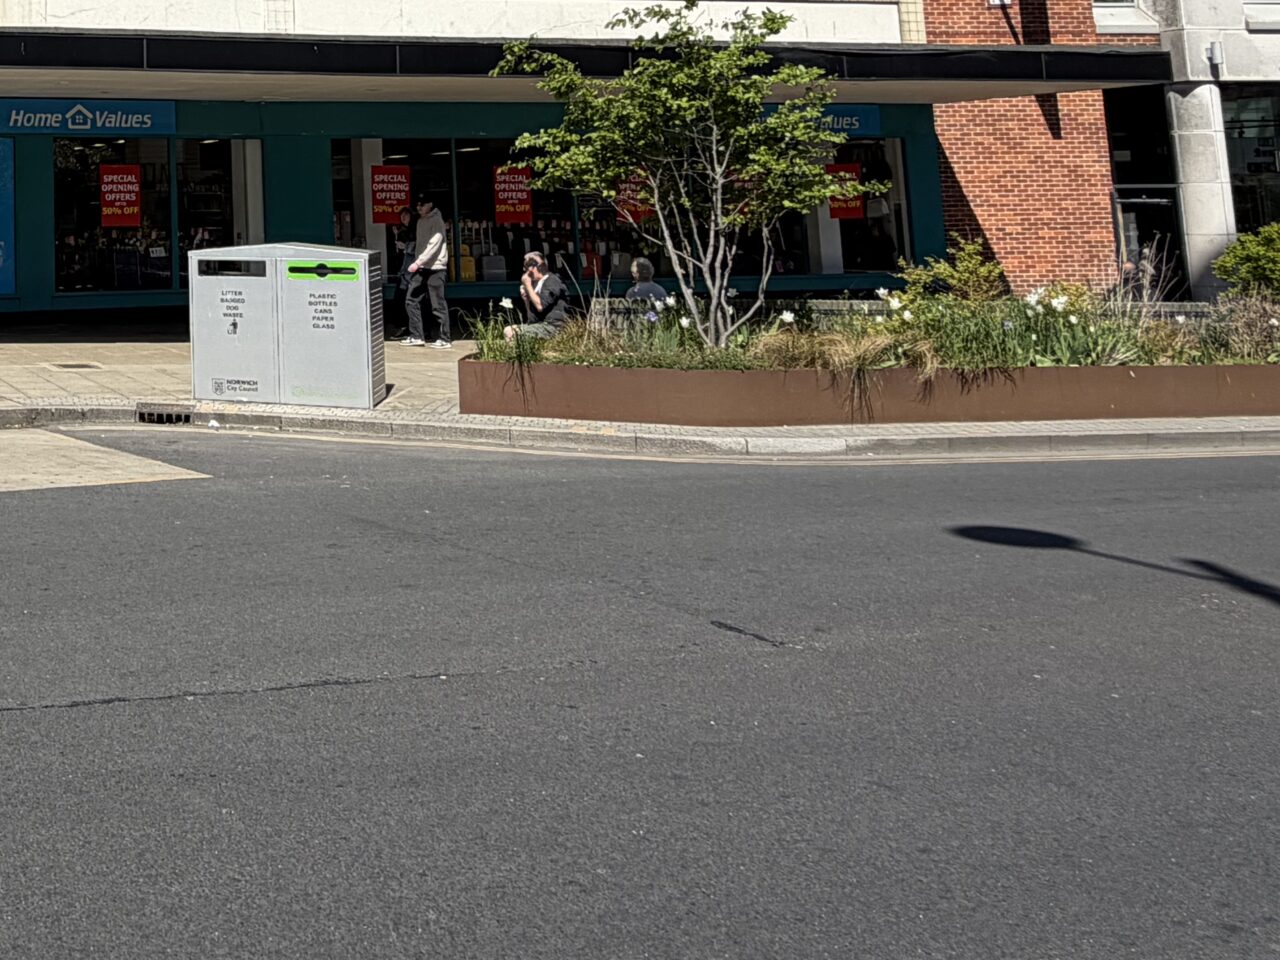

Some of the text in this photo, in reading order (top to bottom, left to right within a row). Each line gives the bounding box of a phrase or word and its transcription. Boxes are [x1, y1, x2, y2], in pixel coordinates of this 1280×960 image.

[9, 110, 152, 128] Home Values
[103, 174, 138, 183] SPECIAL
[373, 174, 408, 182] SPECIAL
[496, 174, 528, 182] SPECIAL
[101, 183, 140, 192] OPENING
[372, 183, 409, 191] OPENING
[105, 193, 136, 201] OFFERS
[498, 191, 527, 199] OFFERS
[102, 206, 140, 215] 50% OFF
[515, 204, 531, 212] OFF
